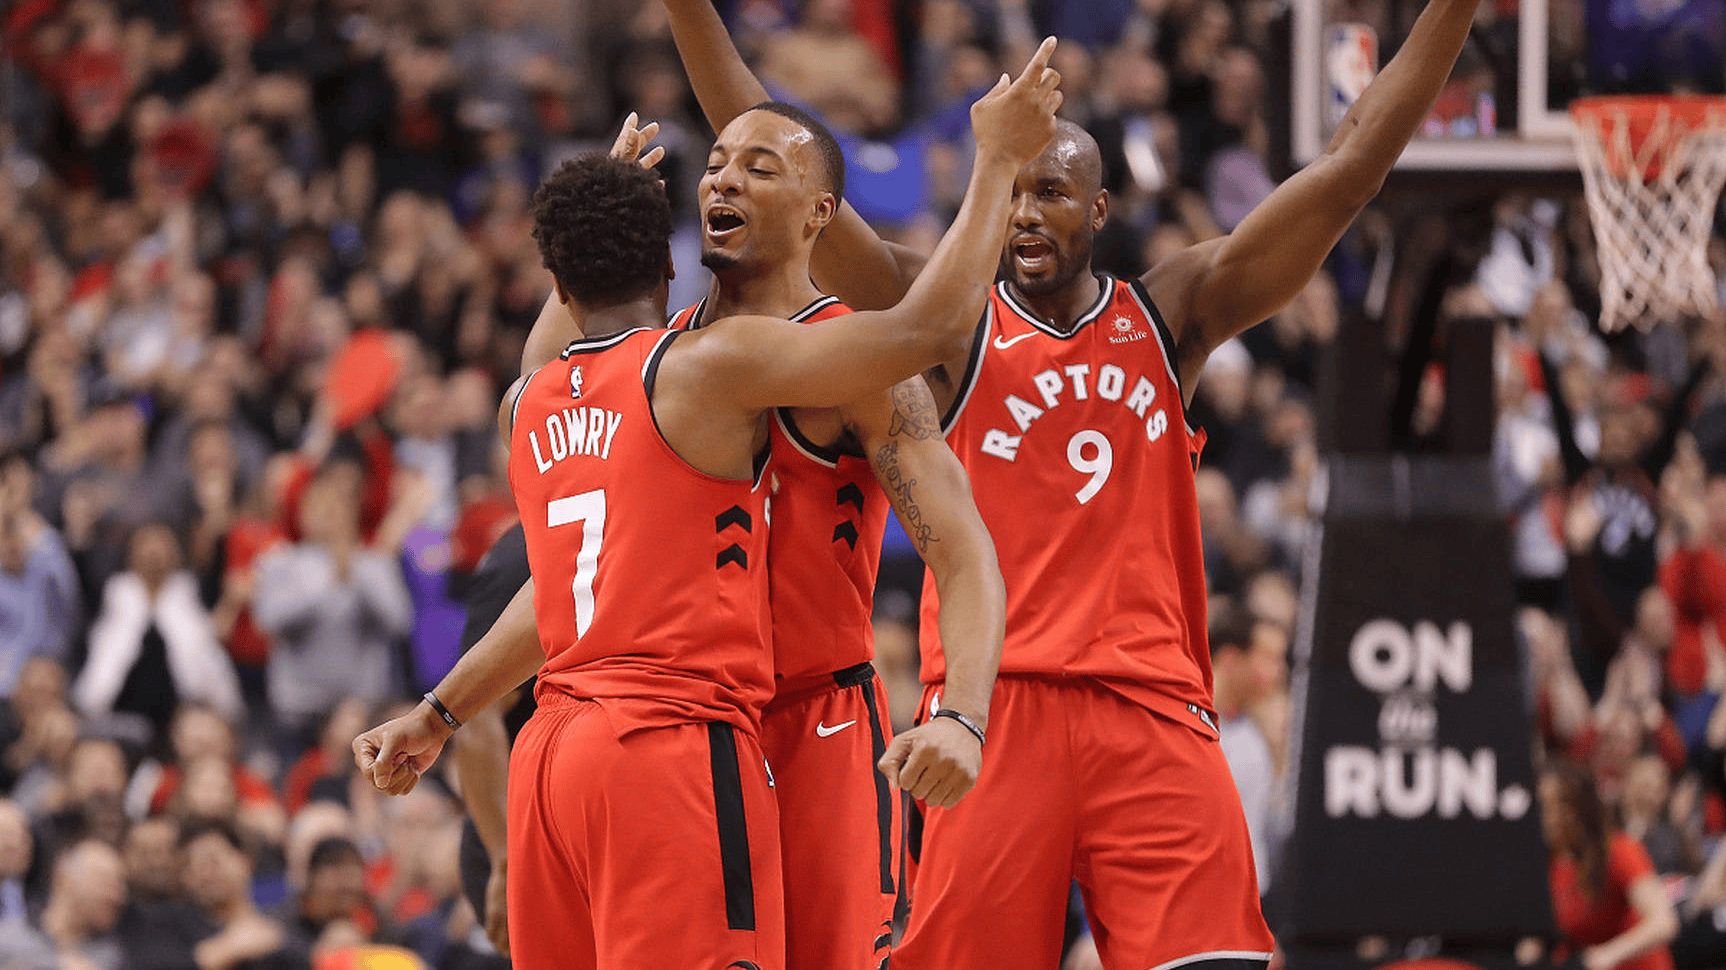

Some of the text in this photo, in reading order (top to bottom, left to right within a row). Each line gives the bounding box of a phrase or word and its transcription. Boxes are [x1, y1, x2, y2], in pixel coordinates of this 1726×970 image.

[529, 406, 623, 475] LOWRY
[981, 364, 1168, 461] RAPTORS
[1067, 430, 1113, 505] 9
[547, 489, 606, 640] 7
[1349, 619, 1473, 692] ON
[1324, 747, 1531, 820] RUN.
